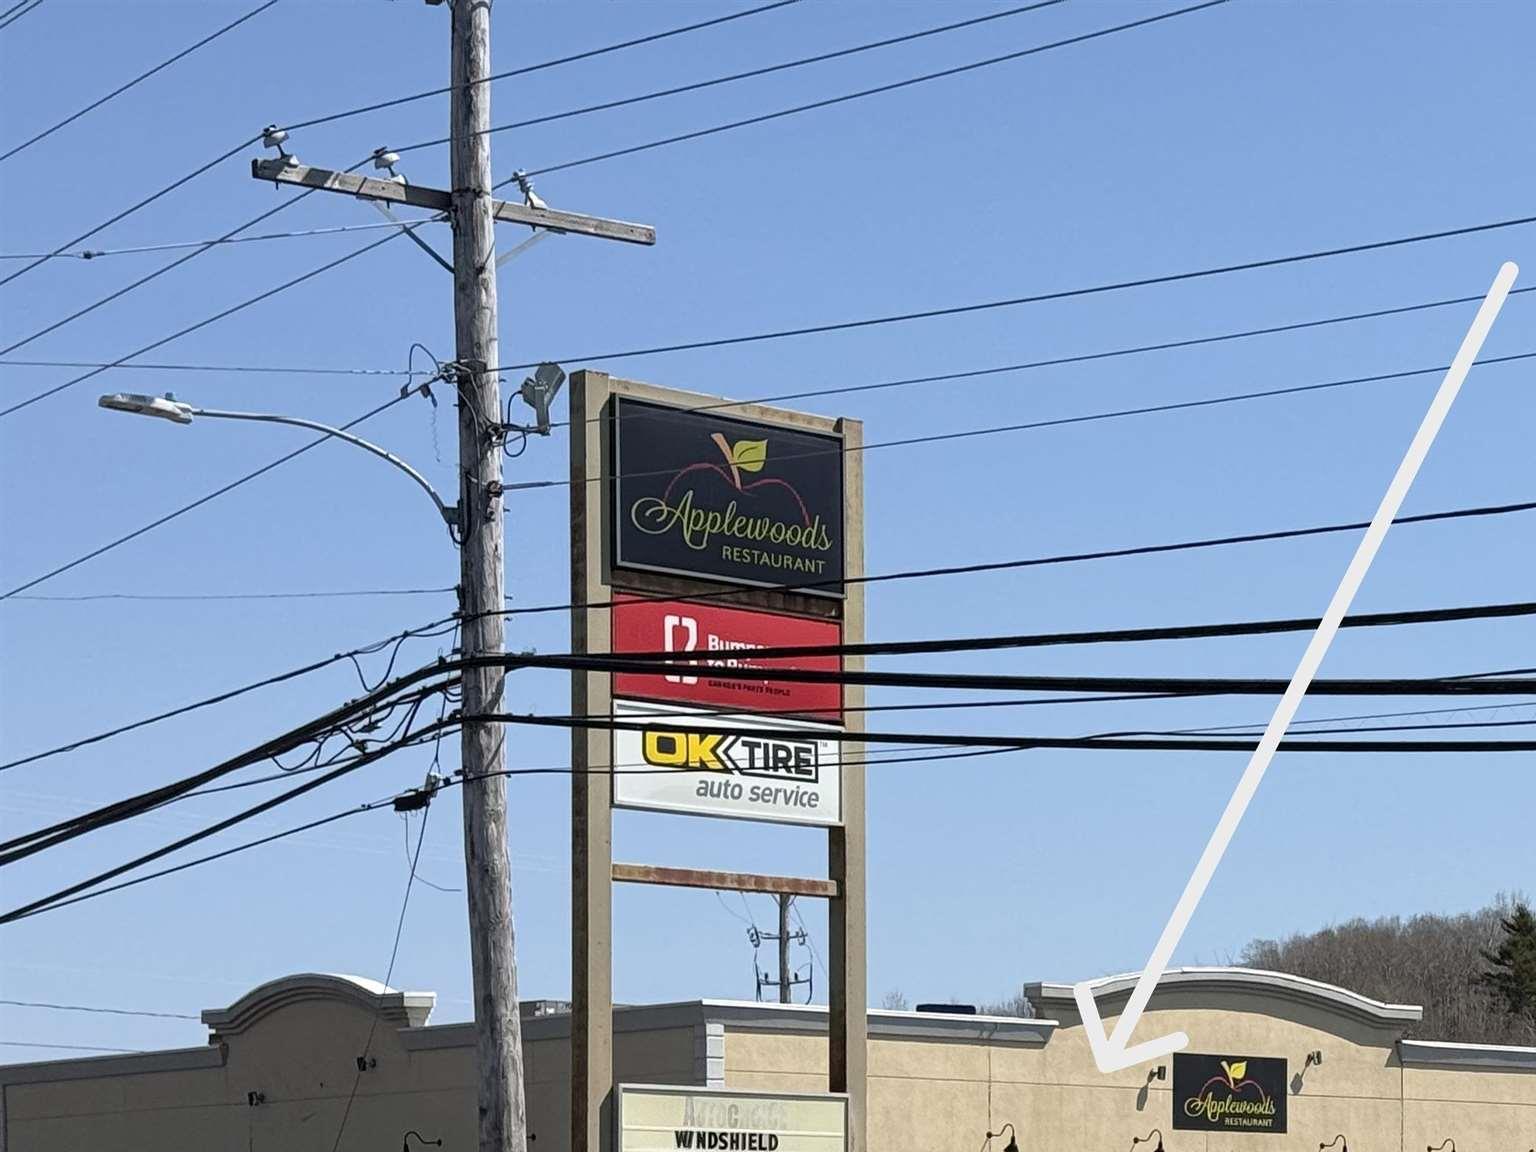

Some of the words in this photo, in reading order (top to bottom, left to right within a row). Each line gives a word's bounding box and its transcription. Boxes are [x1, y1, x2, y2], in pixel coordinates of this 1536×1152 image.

[631, 490, 833, 551] Applewoods
[721, 545, 825, 574] RESTAURANT
[643, 730, 728, 773] OK
[742, 740, 813, 776] TIRE
[696, 779, 743, 800] auto
[748, 785, 819, 808] service
[1184, 1092, 1276, 1122] Applewoods
[1224, 1117, 1273, 1127] RESTAURANT
[674, 1130, 779, 1151] WINDSHIELD
